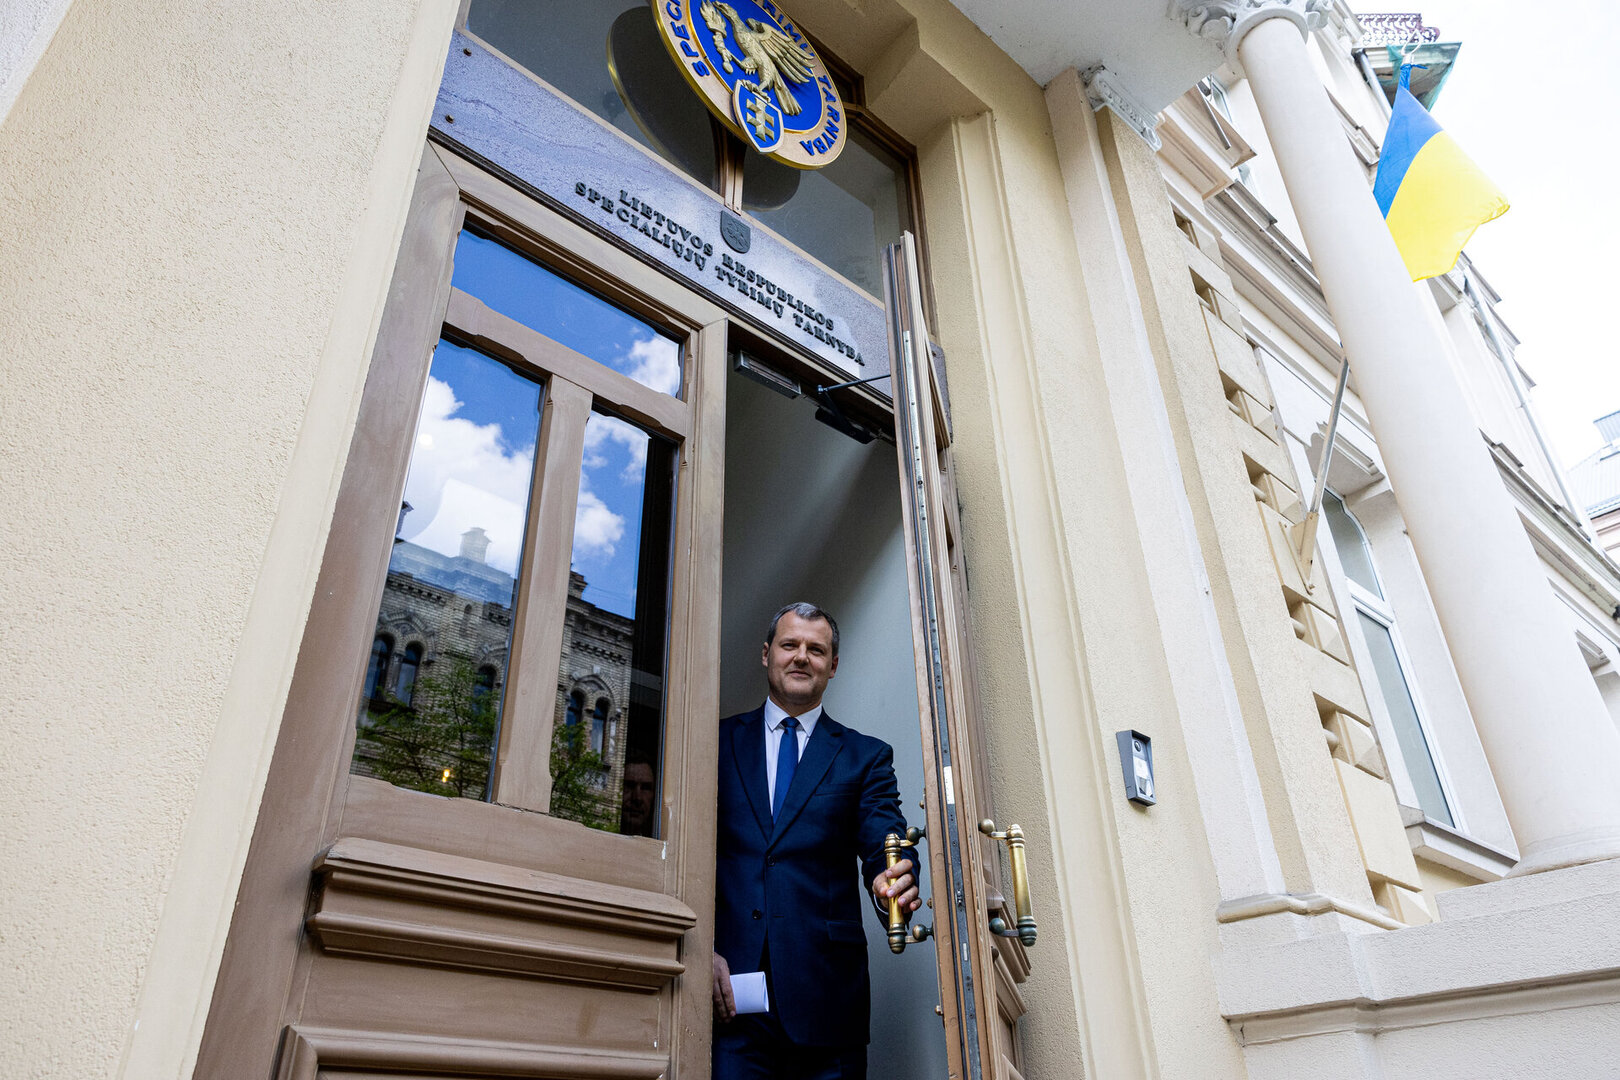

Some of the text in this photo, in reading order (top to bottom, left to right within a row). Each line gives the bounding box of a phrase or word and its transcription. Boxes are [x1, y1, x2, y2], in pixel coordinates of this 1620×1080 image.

[799, 75, 840, 156] TARNYBA
[575, 181, 866, 367] SPECIALIŲJŲ TYRIMŲ TARNYBA
[619, 189, 834, 331] LIETUVOS RESPUBLIKOS
